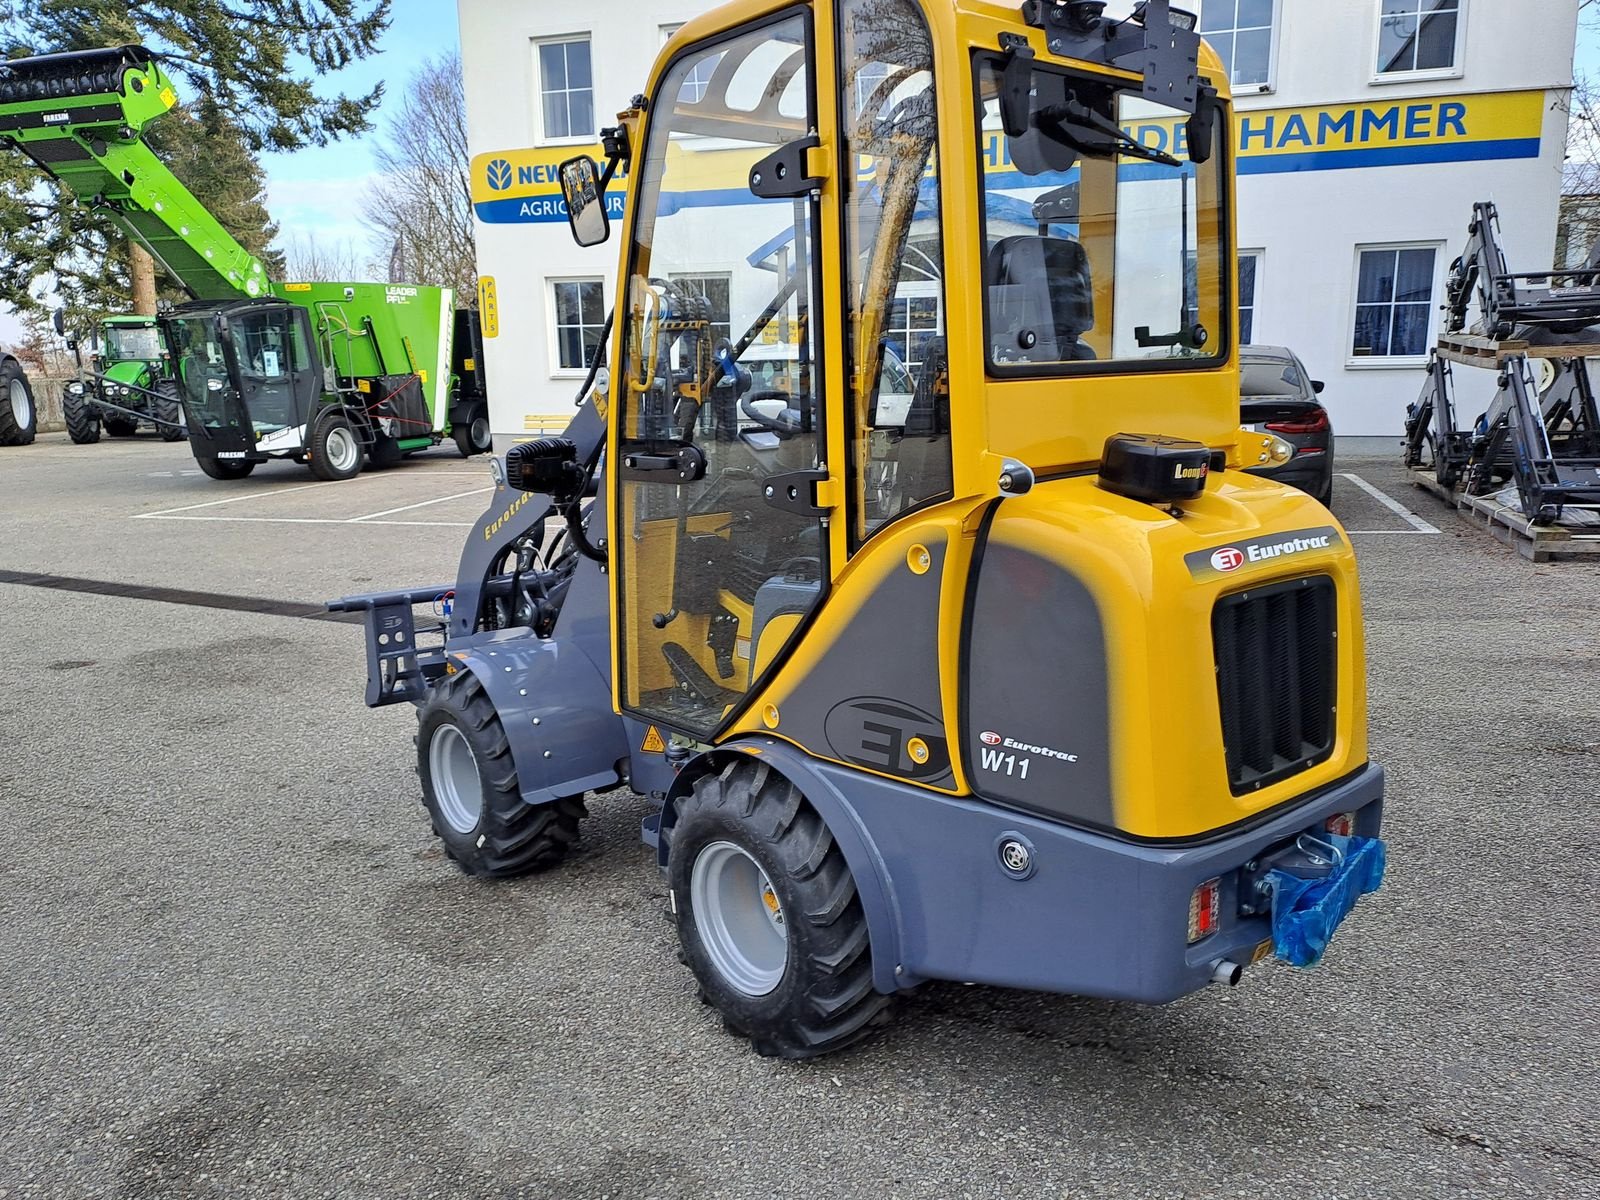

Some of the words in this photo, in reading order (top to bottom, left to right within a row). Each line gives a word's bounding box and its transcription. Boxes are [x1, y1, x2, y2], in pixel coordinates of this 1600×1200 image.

[487, 281, 496, 331] PARTS
[1246, 535, 1330, 562] Eurotrac
[981, 747, 1030, 780] W11
[1003, 737, 1078, 763] Eurotrac
